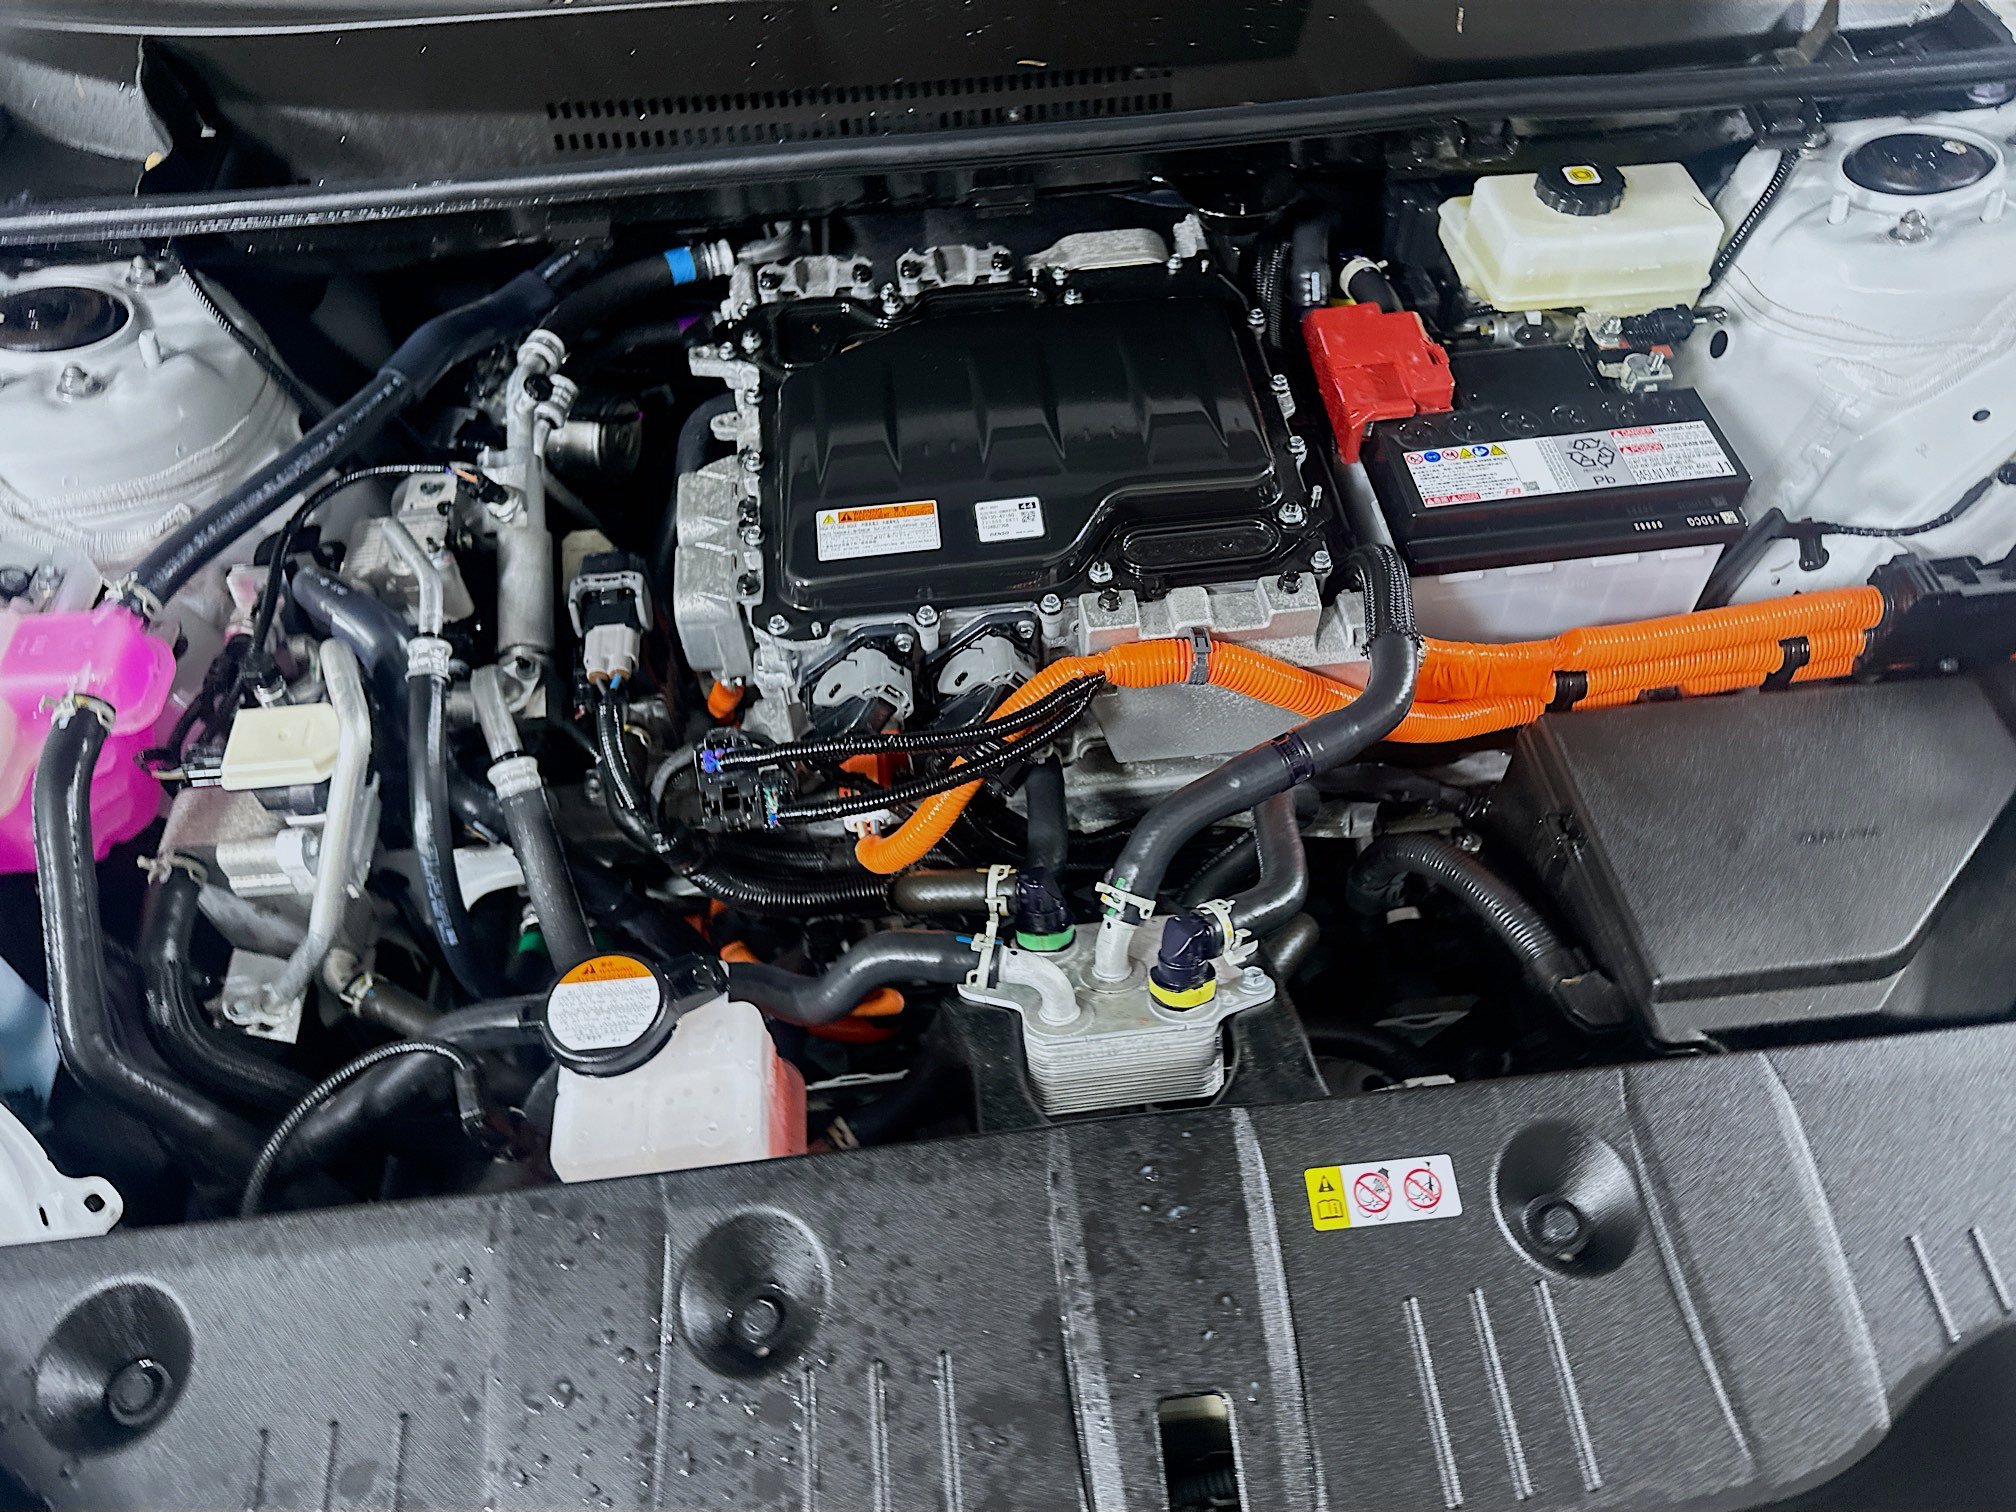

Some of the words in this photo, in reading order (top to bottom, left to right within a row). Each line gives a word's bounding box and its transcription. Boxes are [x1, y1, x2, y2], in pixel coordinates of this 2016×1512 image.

[1621, 427, 1652, 436] DANGER
[1629, 443, 1662, 452] POISON
[1593, 474, 1616, 486] Pb
